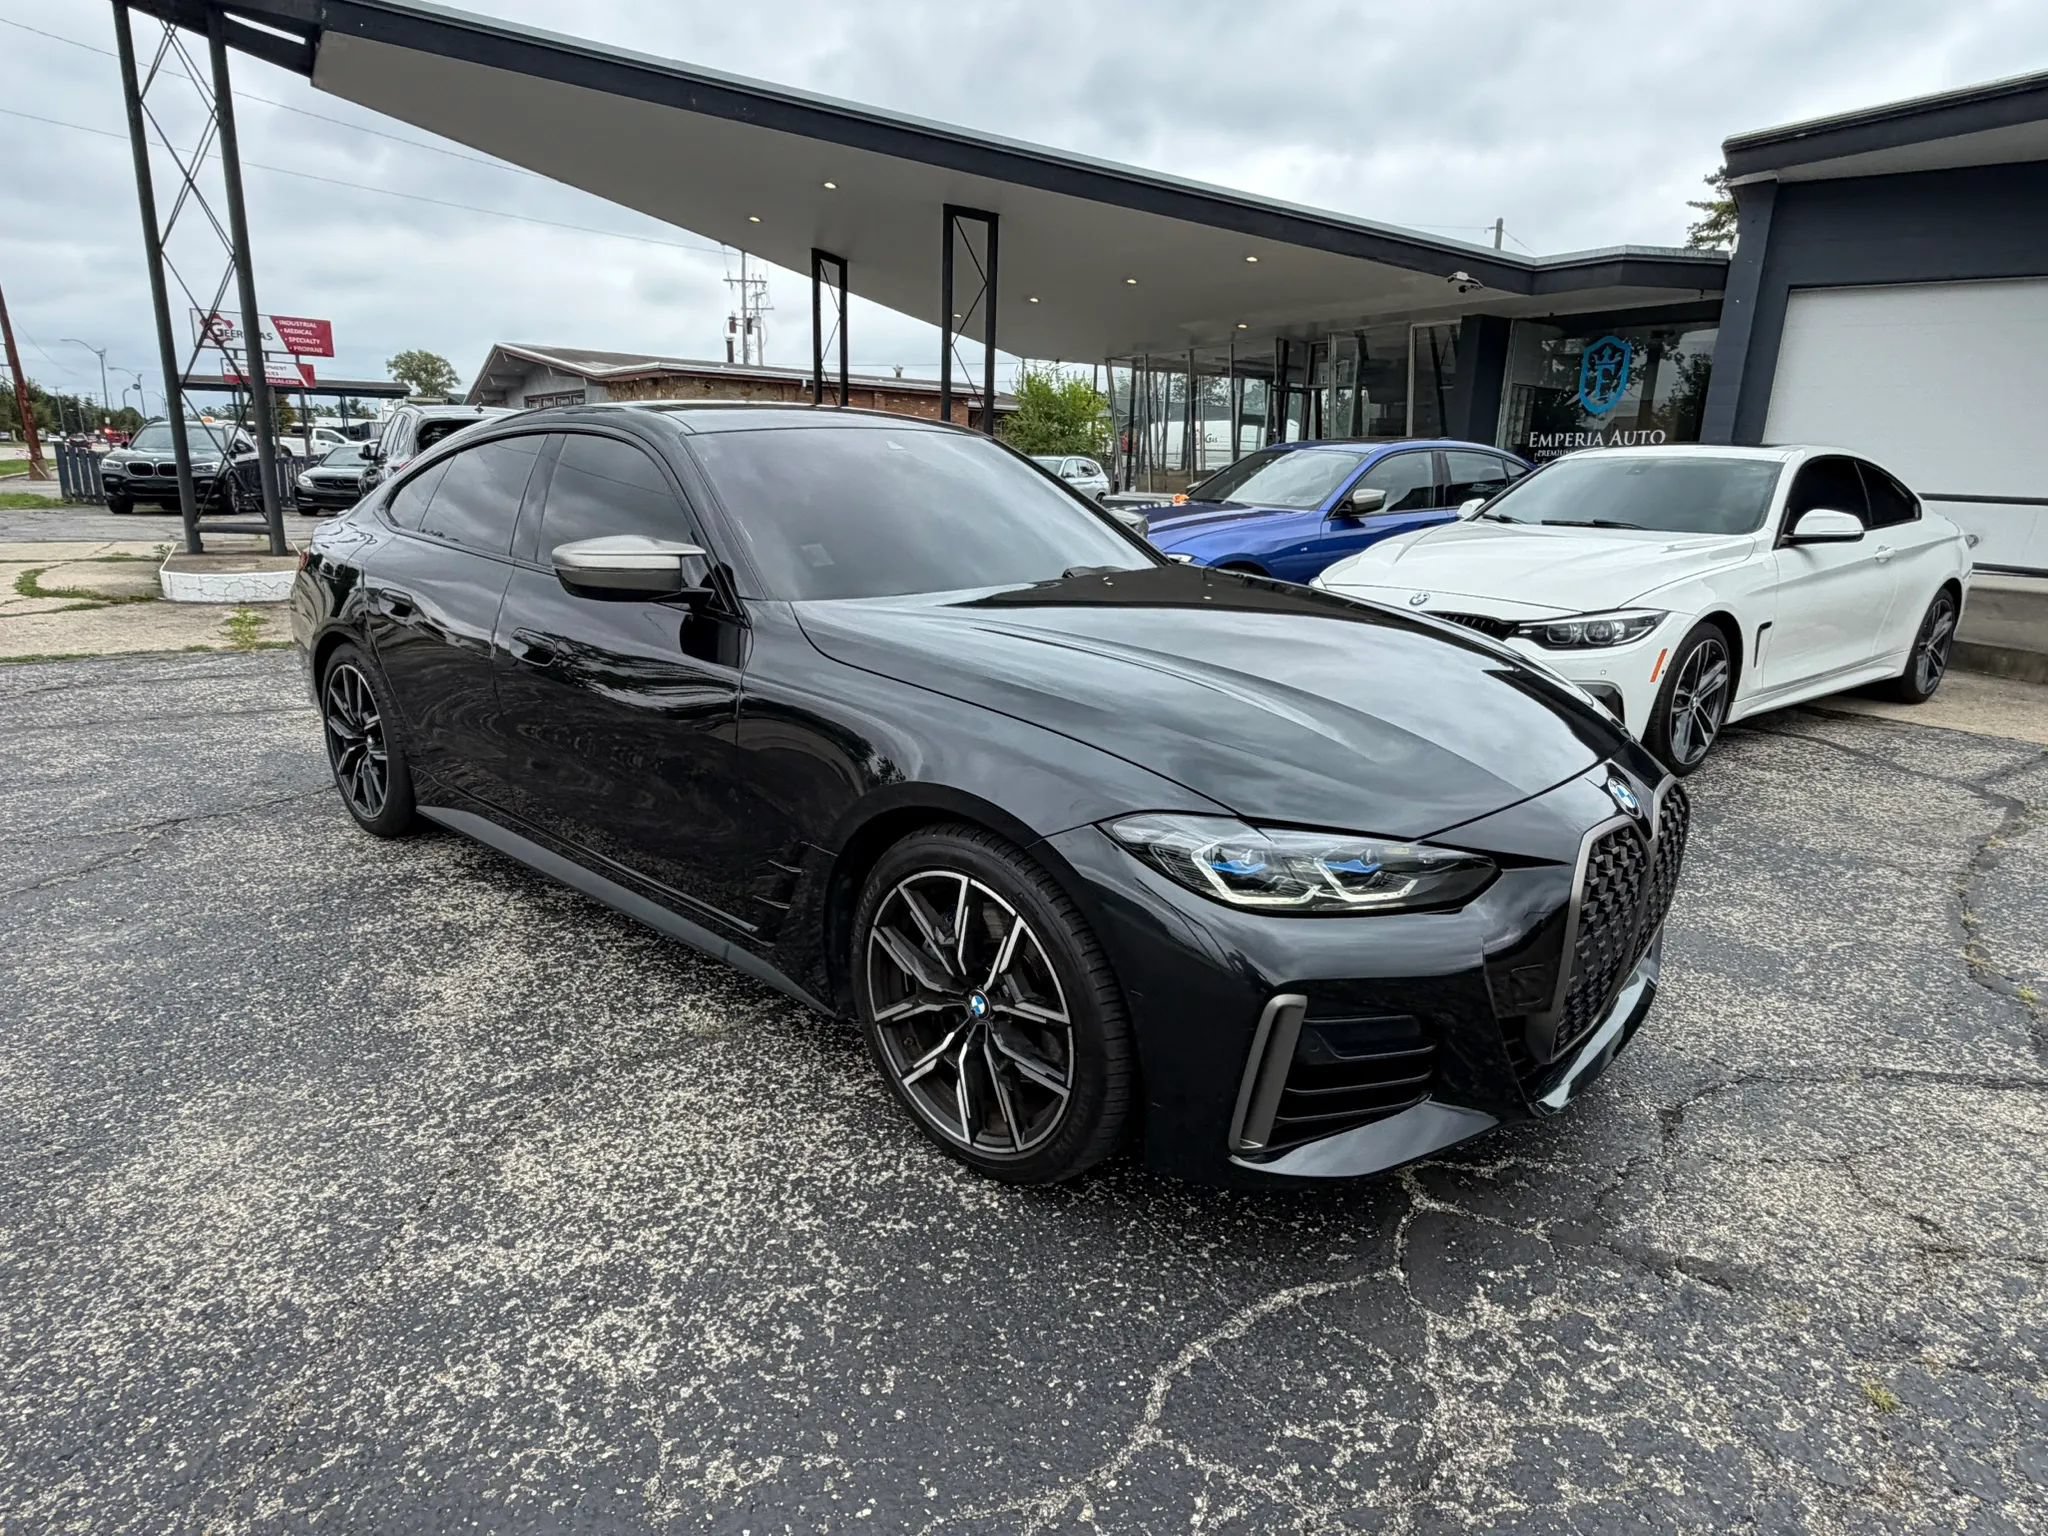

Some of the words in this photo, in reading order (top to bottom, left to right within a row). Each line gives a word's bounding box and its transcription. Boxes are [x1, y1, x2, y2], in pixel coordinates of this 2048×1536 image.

[279, 320, 317, 328] INDUSTRIAL
[283, 328, 313, 336] MEDICAL
[288, 336, 321, 344] SPECIALTY
[1529, 431, 1604, 448] EMPERIA
[1608, 429, 1666, 446] AUTO
